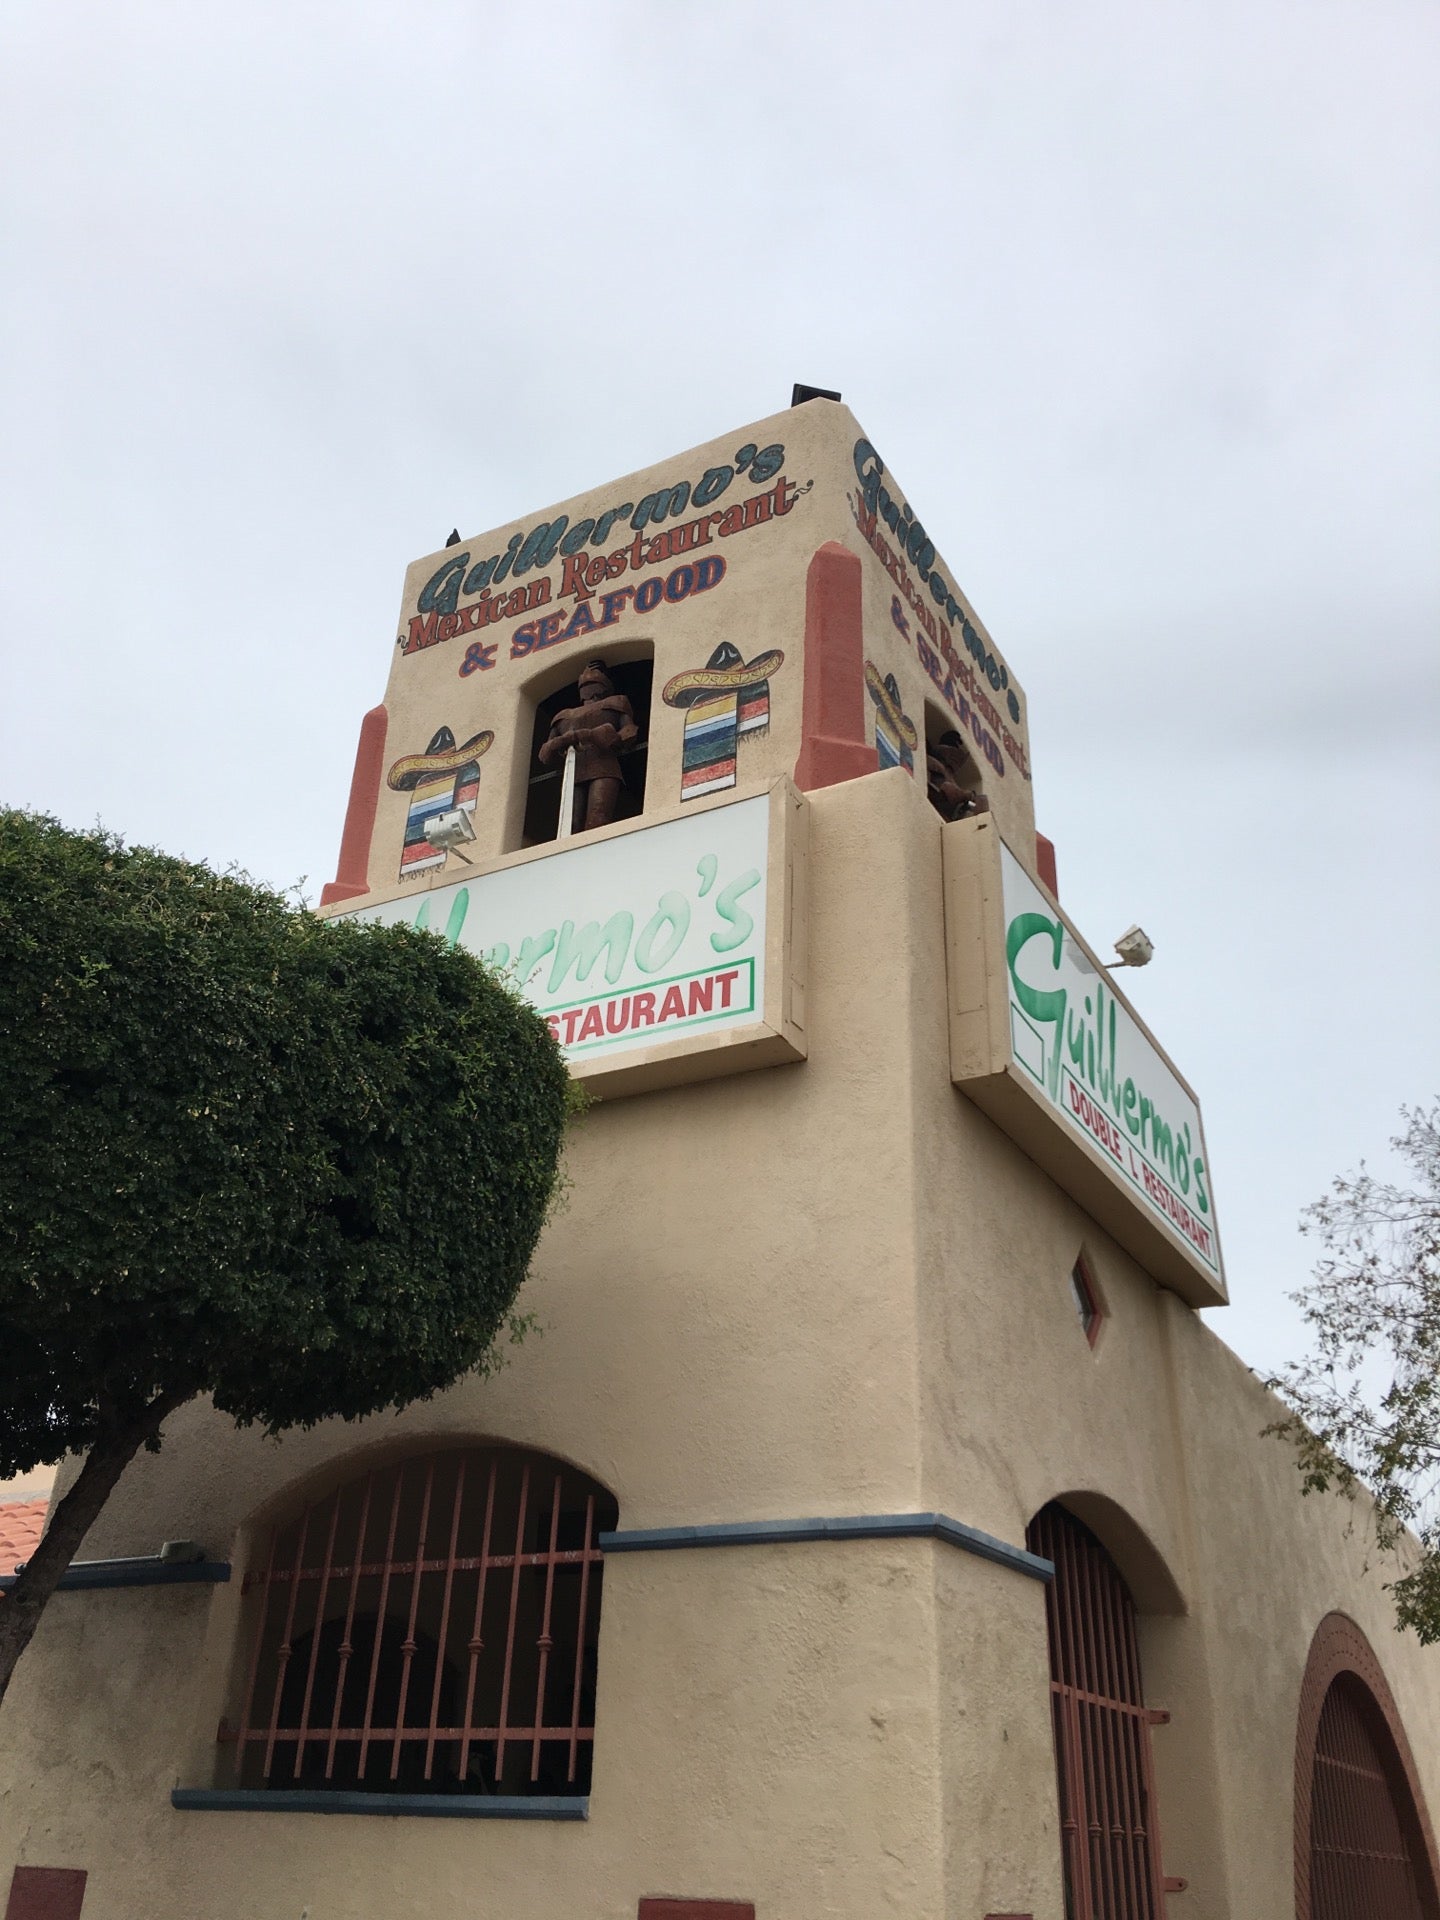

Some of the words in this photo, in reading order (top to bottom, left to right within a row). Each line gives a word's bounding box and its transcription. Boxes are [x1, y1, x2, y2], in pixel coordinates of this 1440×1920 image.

[402, 576, 552, 656] Mexican
[558, 475, 797, 603] Restaurant
[417, 443, 785, 614] Guillermo's
[458, 641, 498, 678] &
[510, 555, 727, 659] SEAFOOD
[546, 970, 739, 1045] STAURANT
[1006, 912, 1209, 1213] Guillermo's
[1069, 1079, 1123, 1163] DOUBLE
[1128, 1146, 1139, 1180] L
[1141, 1161, 1211, 1258] RESTAURANT
